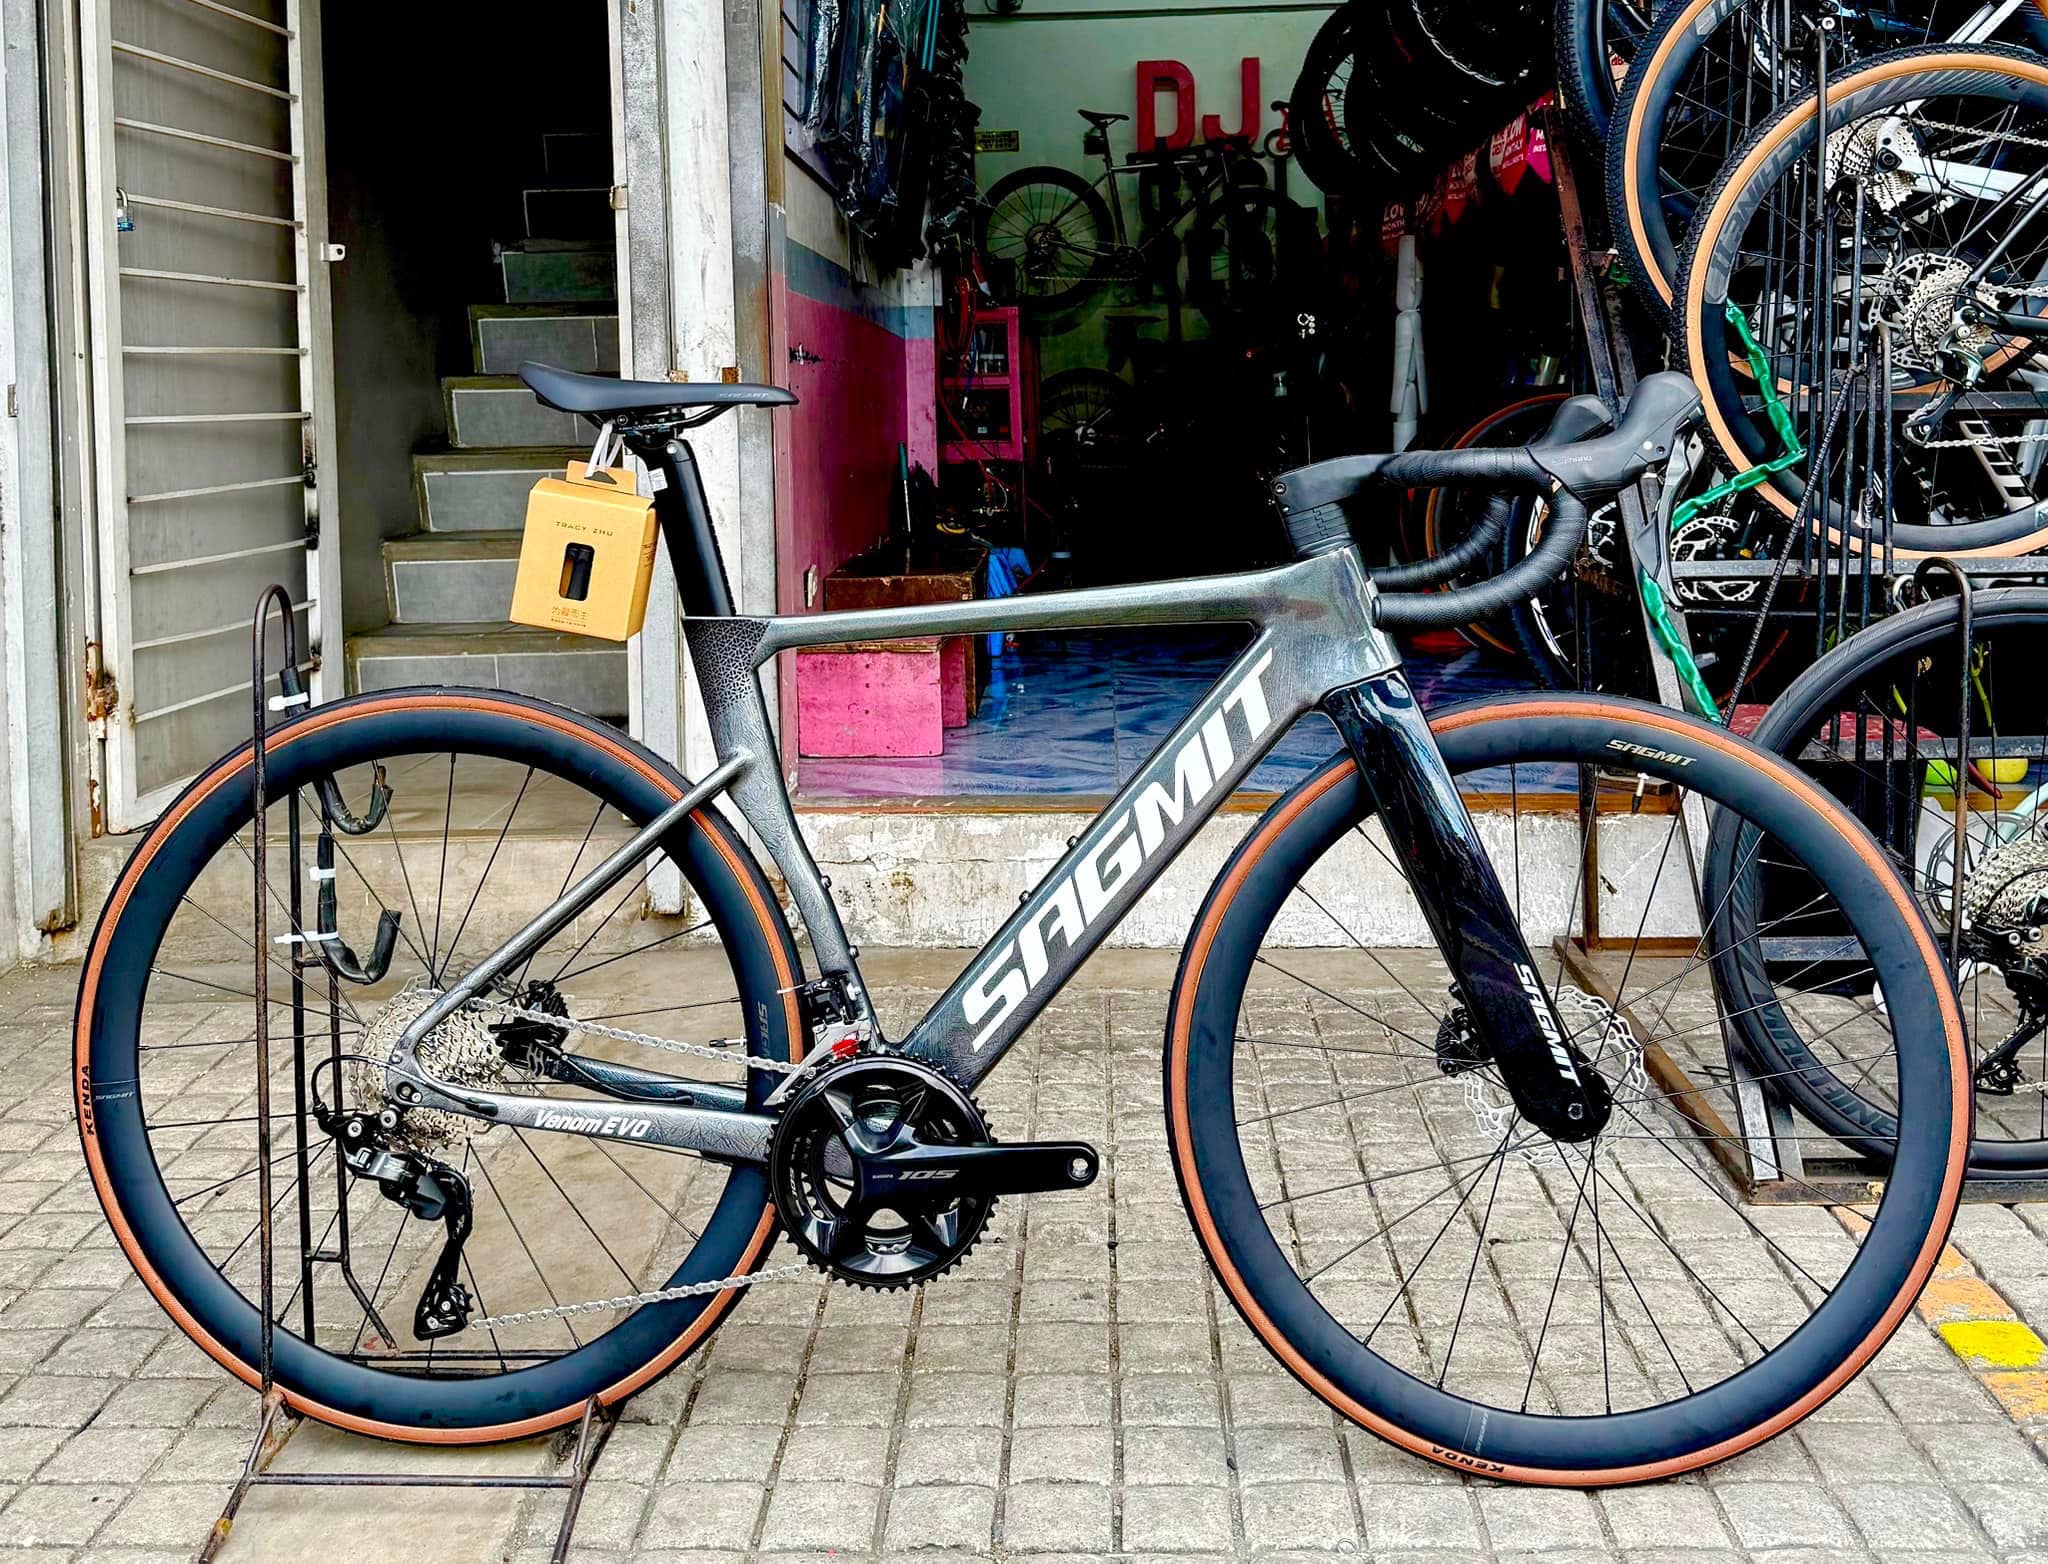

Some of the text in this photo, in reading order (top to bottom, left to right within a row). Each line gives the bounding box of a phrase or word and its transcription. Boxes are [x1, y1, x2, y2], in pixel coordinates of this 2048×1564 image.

[1137, 57, 1261, 153] DJ
[556, 521, 613, 537] TRACY ZHU
[1605, 739, 1697, 767] SAGMIT
[962, 648, 1273, 1053] SAGMIT
[758, 1000, 776, 1086] SAGMT
[1513, 962, 1582, 1087] SAGMIT
[81, 1065, 95, 1136] KENDA
[534, 1109, 652, 1138] Venom EVO
[898, 1169, 960, 1181] 105
[1432, 1446, 1505, 1473] KENDA
